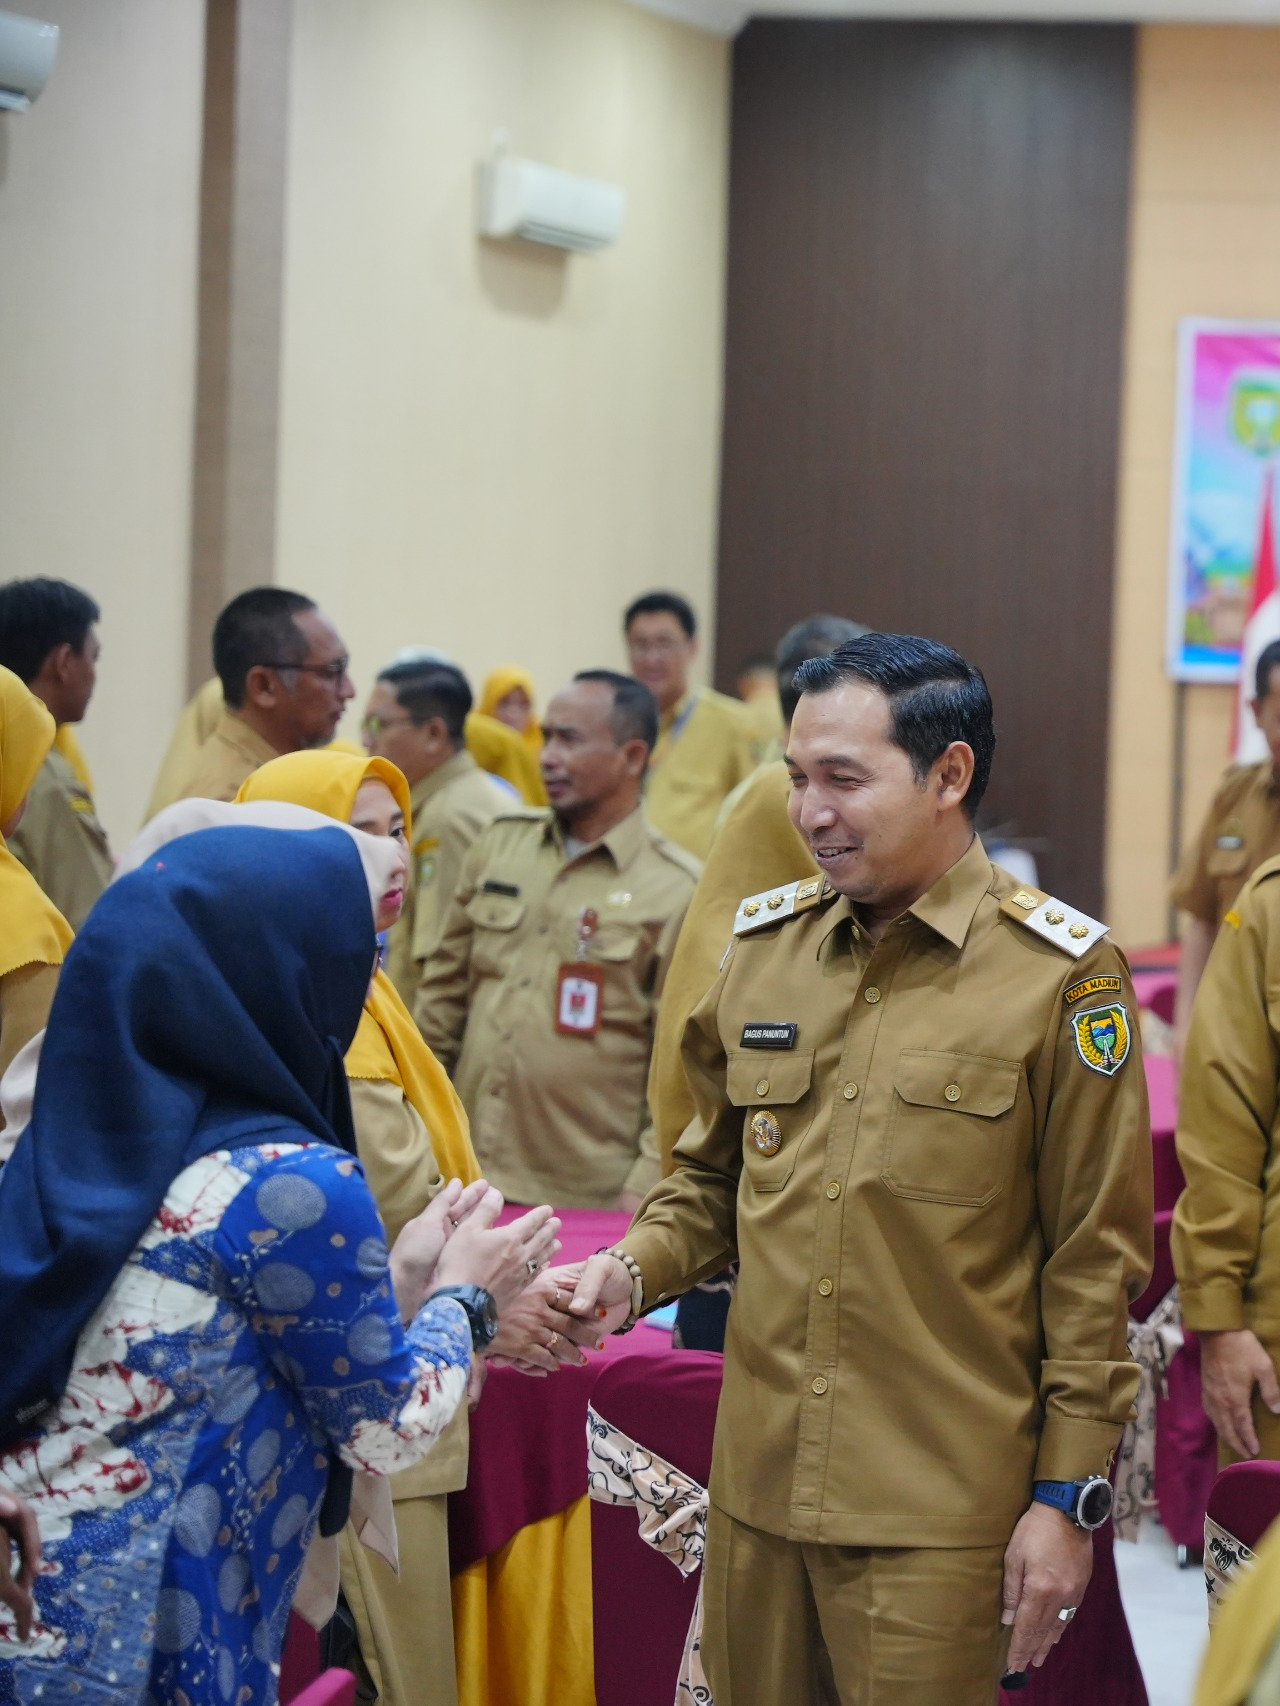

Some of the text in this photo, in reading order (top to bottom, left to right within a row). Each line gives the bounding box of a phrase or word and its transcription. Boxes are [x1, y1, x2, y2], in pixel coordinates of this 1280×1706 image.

[1066, 979, 1119, 1001] KOTA MADIUN
[744, 1029, 762, 1039] BAGUS
